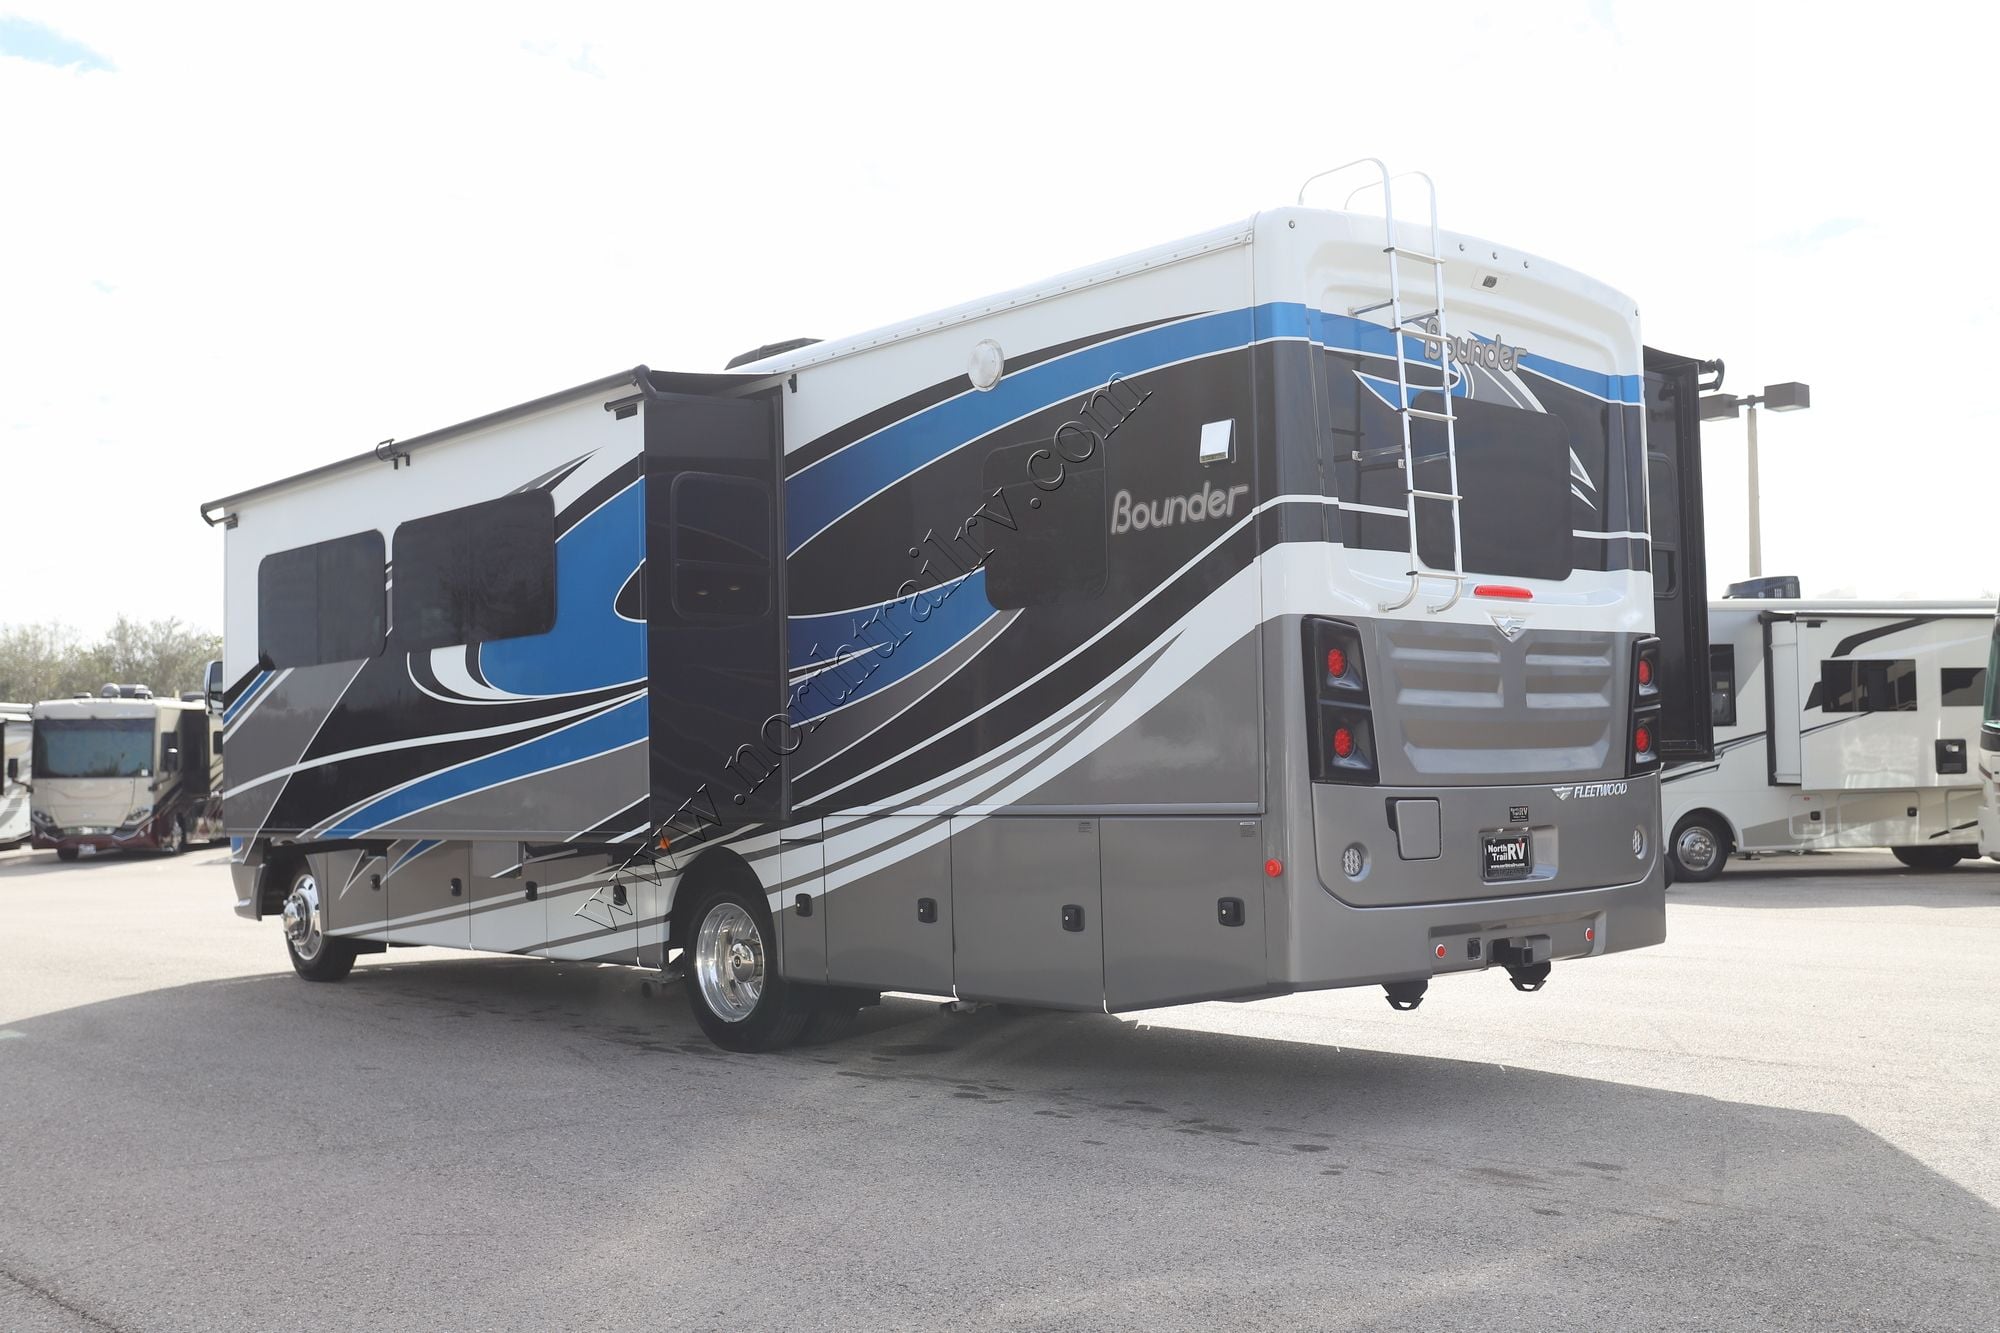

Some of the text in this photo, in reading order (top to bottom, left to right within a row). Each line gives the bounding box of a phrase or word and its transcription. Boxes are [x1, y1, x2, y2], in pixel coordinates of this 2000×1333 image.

[1424, 317, 1528, 373] Bounder
[1110, 480, 1249, 534] Bounder
[1573, 782, 1628, 799] FLEETWOOD
[1487, 844, 1508, 853] North
[1491, 852, 1508, 861] Trail
[1507, 842, 1526, 861] RV
